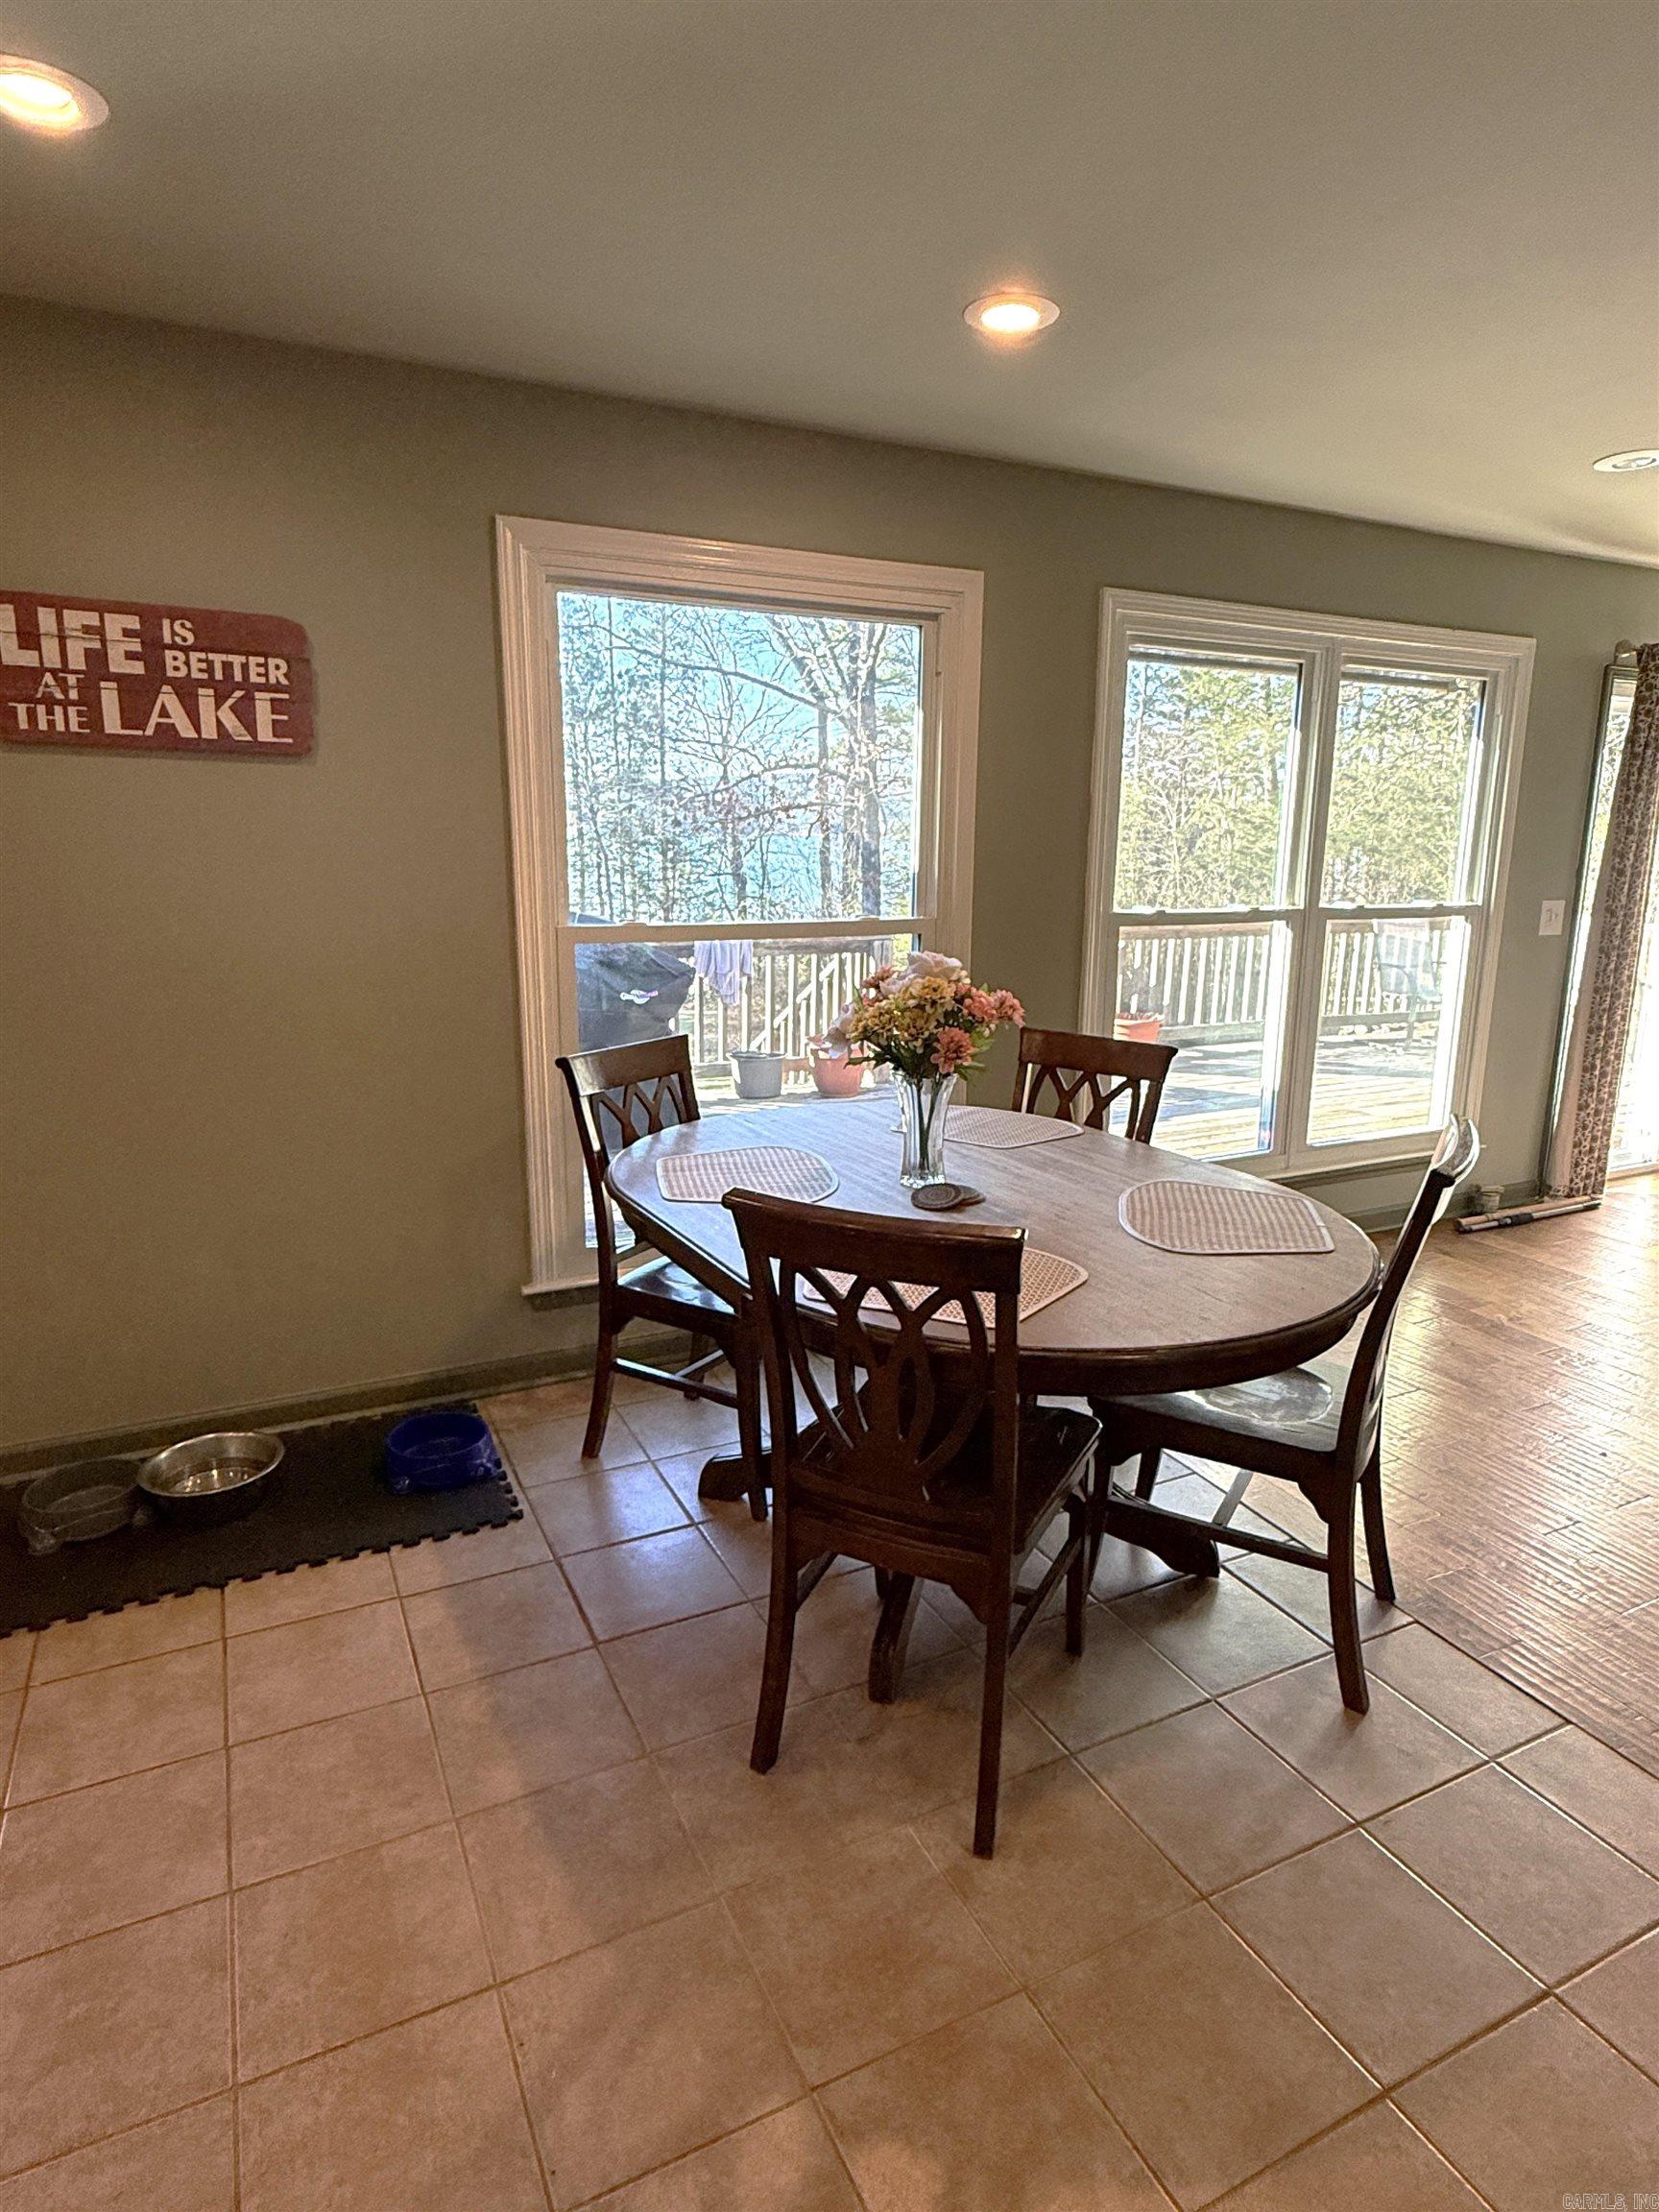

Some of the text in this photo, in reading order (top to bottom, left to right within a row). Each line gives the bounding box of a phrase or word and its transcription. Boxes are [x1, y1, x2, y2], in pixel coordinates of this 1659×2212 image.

[0, 603, 145, 675] LIFE
[162, 617, 195, 646] IS
[164, 649, 290, 685] BETTER
[36, 672, 84, 701] AT
[8, 702, 91, 733] THE
[99, 681, 293, 743] LAKE
